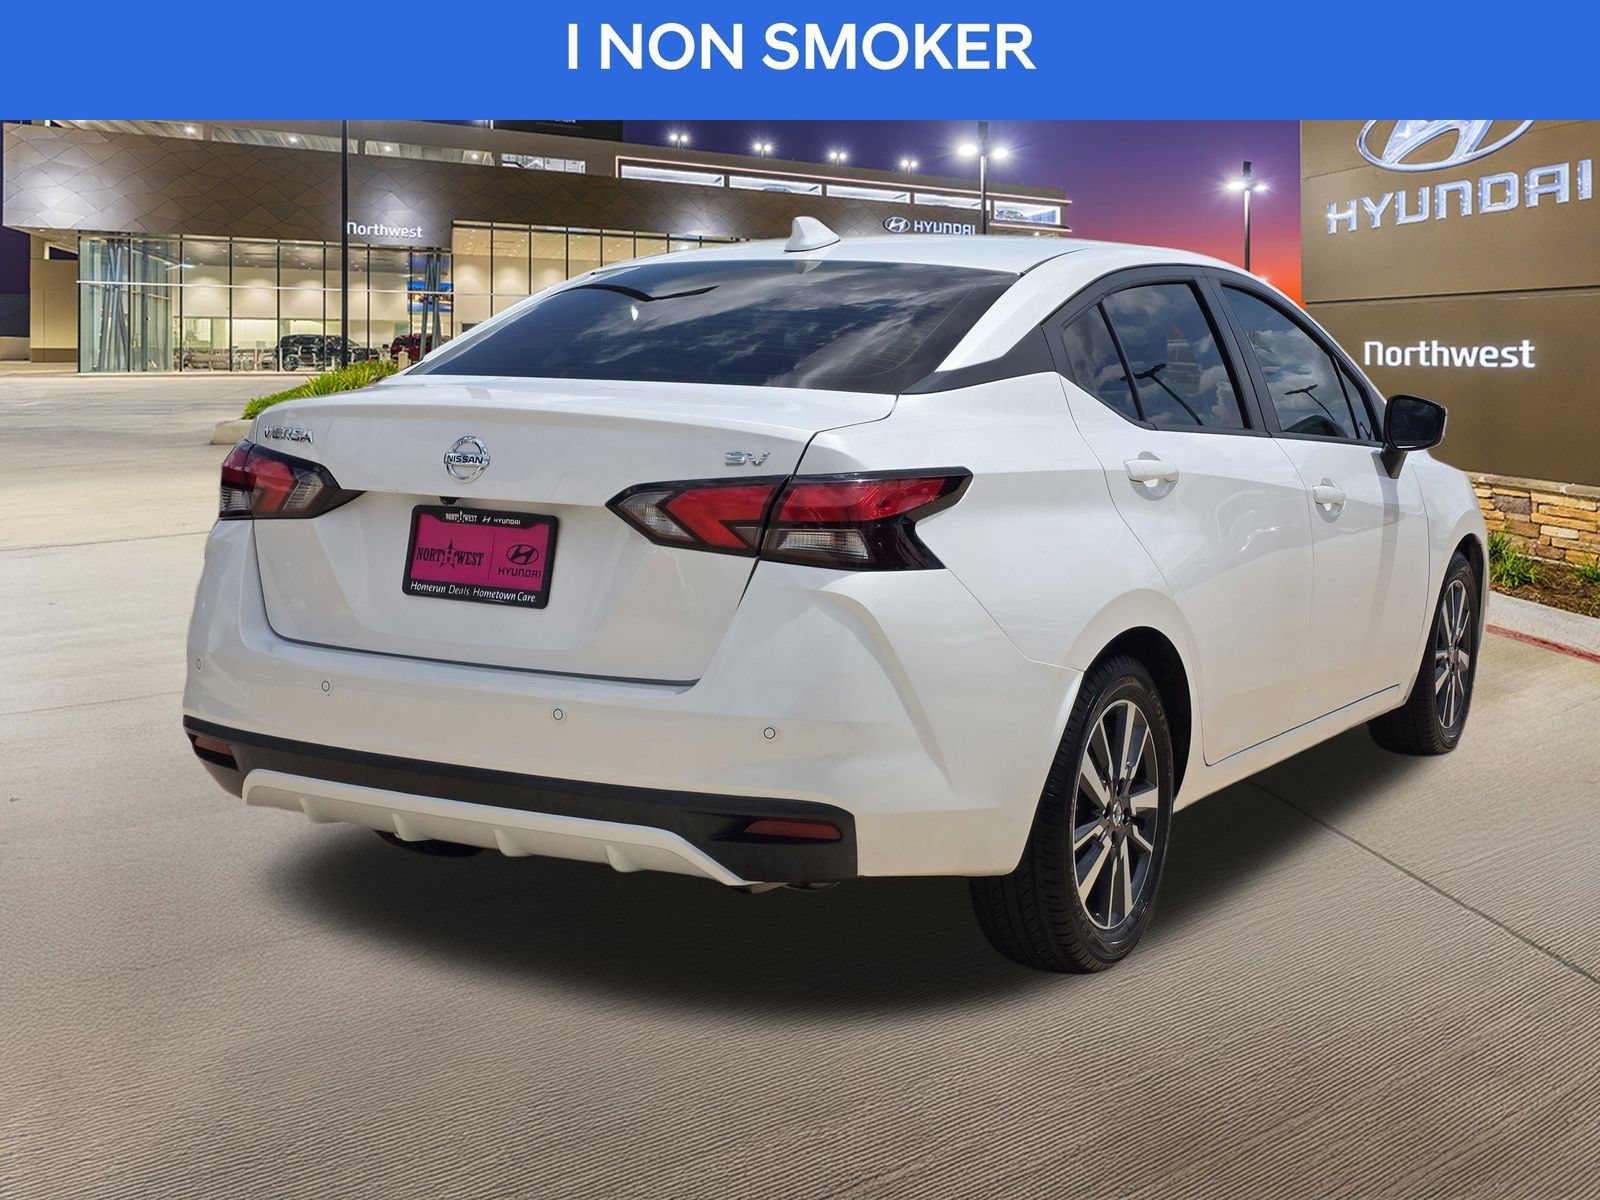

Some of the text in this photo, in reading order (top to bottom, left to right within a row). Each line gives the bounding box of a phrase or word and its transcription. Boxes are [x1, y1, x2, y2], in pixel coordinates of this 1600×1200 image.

[1326, 158, 1593, 235] HYUNDAI
[347, 221, 423, 239] Northwest
[913, 220, 976, 235] HYUNDAI
[1363, 339, 1536, 368] Northwest
[264, 425, 314, 444] VERSA
[446, 454, 484, 464] NISSAN
[724, 450, 770, 467] SV
[498, 566, 542, 579] HYUNDAI
[410, 581, 446, 593] Homerun
[448, 584, 470, 596] Deals
[472, 588, 516, 601] Hometown
